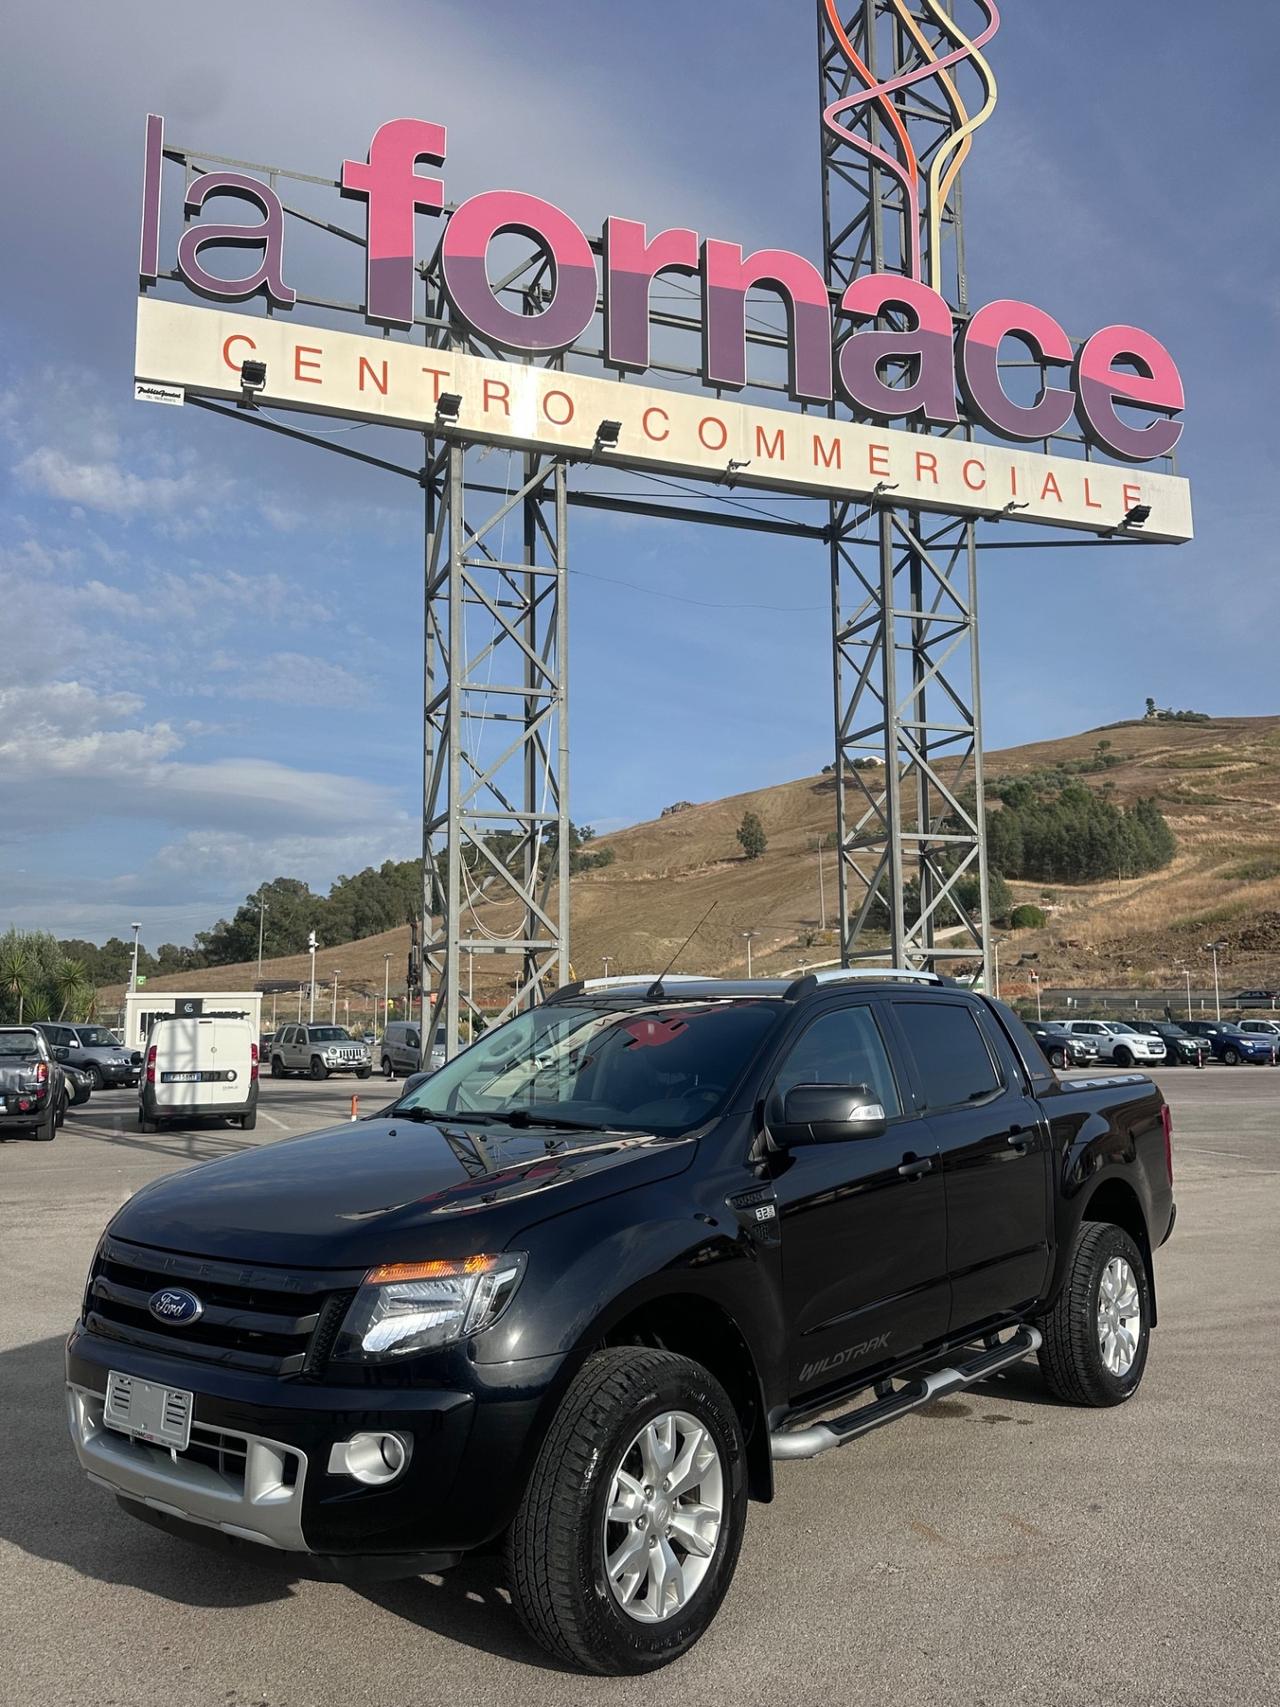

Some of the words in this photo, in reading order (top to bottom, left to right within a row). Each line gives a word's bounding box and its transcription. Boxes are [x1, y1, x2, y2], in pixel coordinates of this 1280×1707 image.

[139, 113, 296, 304] la
[340, 117, 1185, 462] fornace
[222, 334, 575, 426] CENTRO
[642, 406, 1141, 512] COMMERCIALE
[154, 1291, 186, 1317] Ford
[798, 1331, 892, 1382] WILDTRAK
